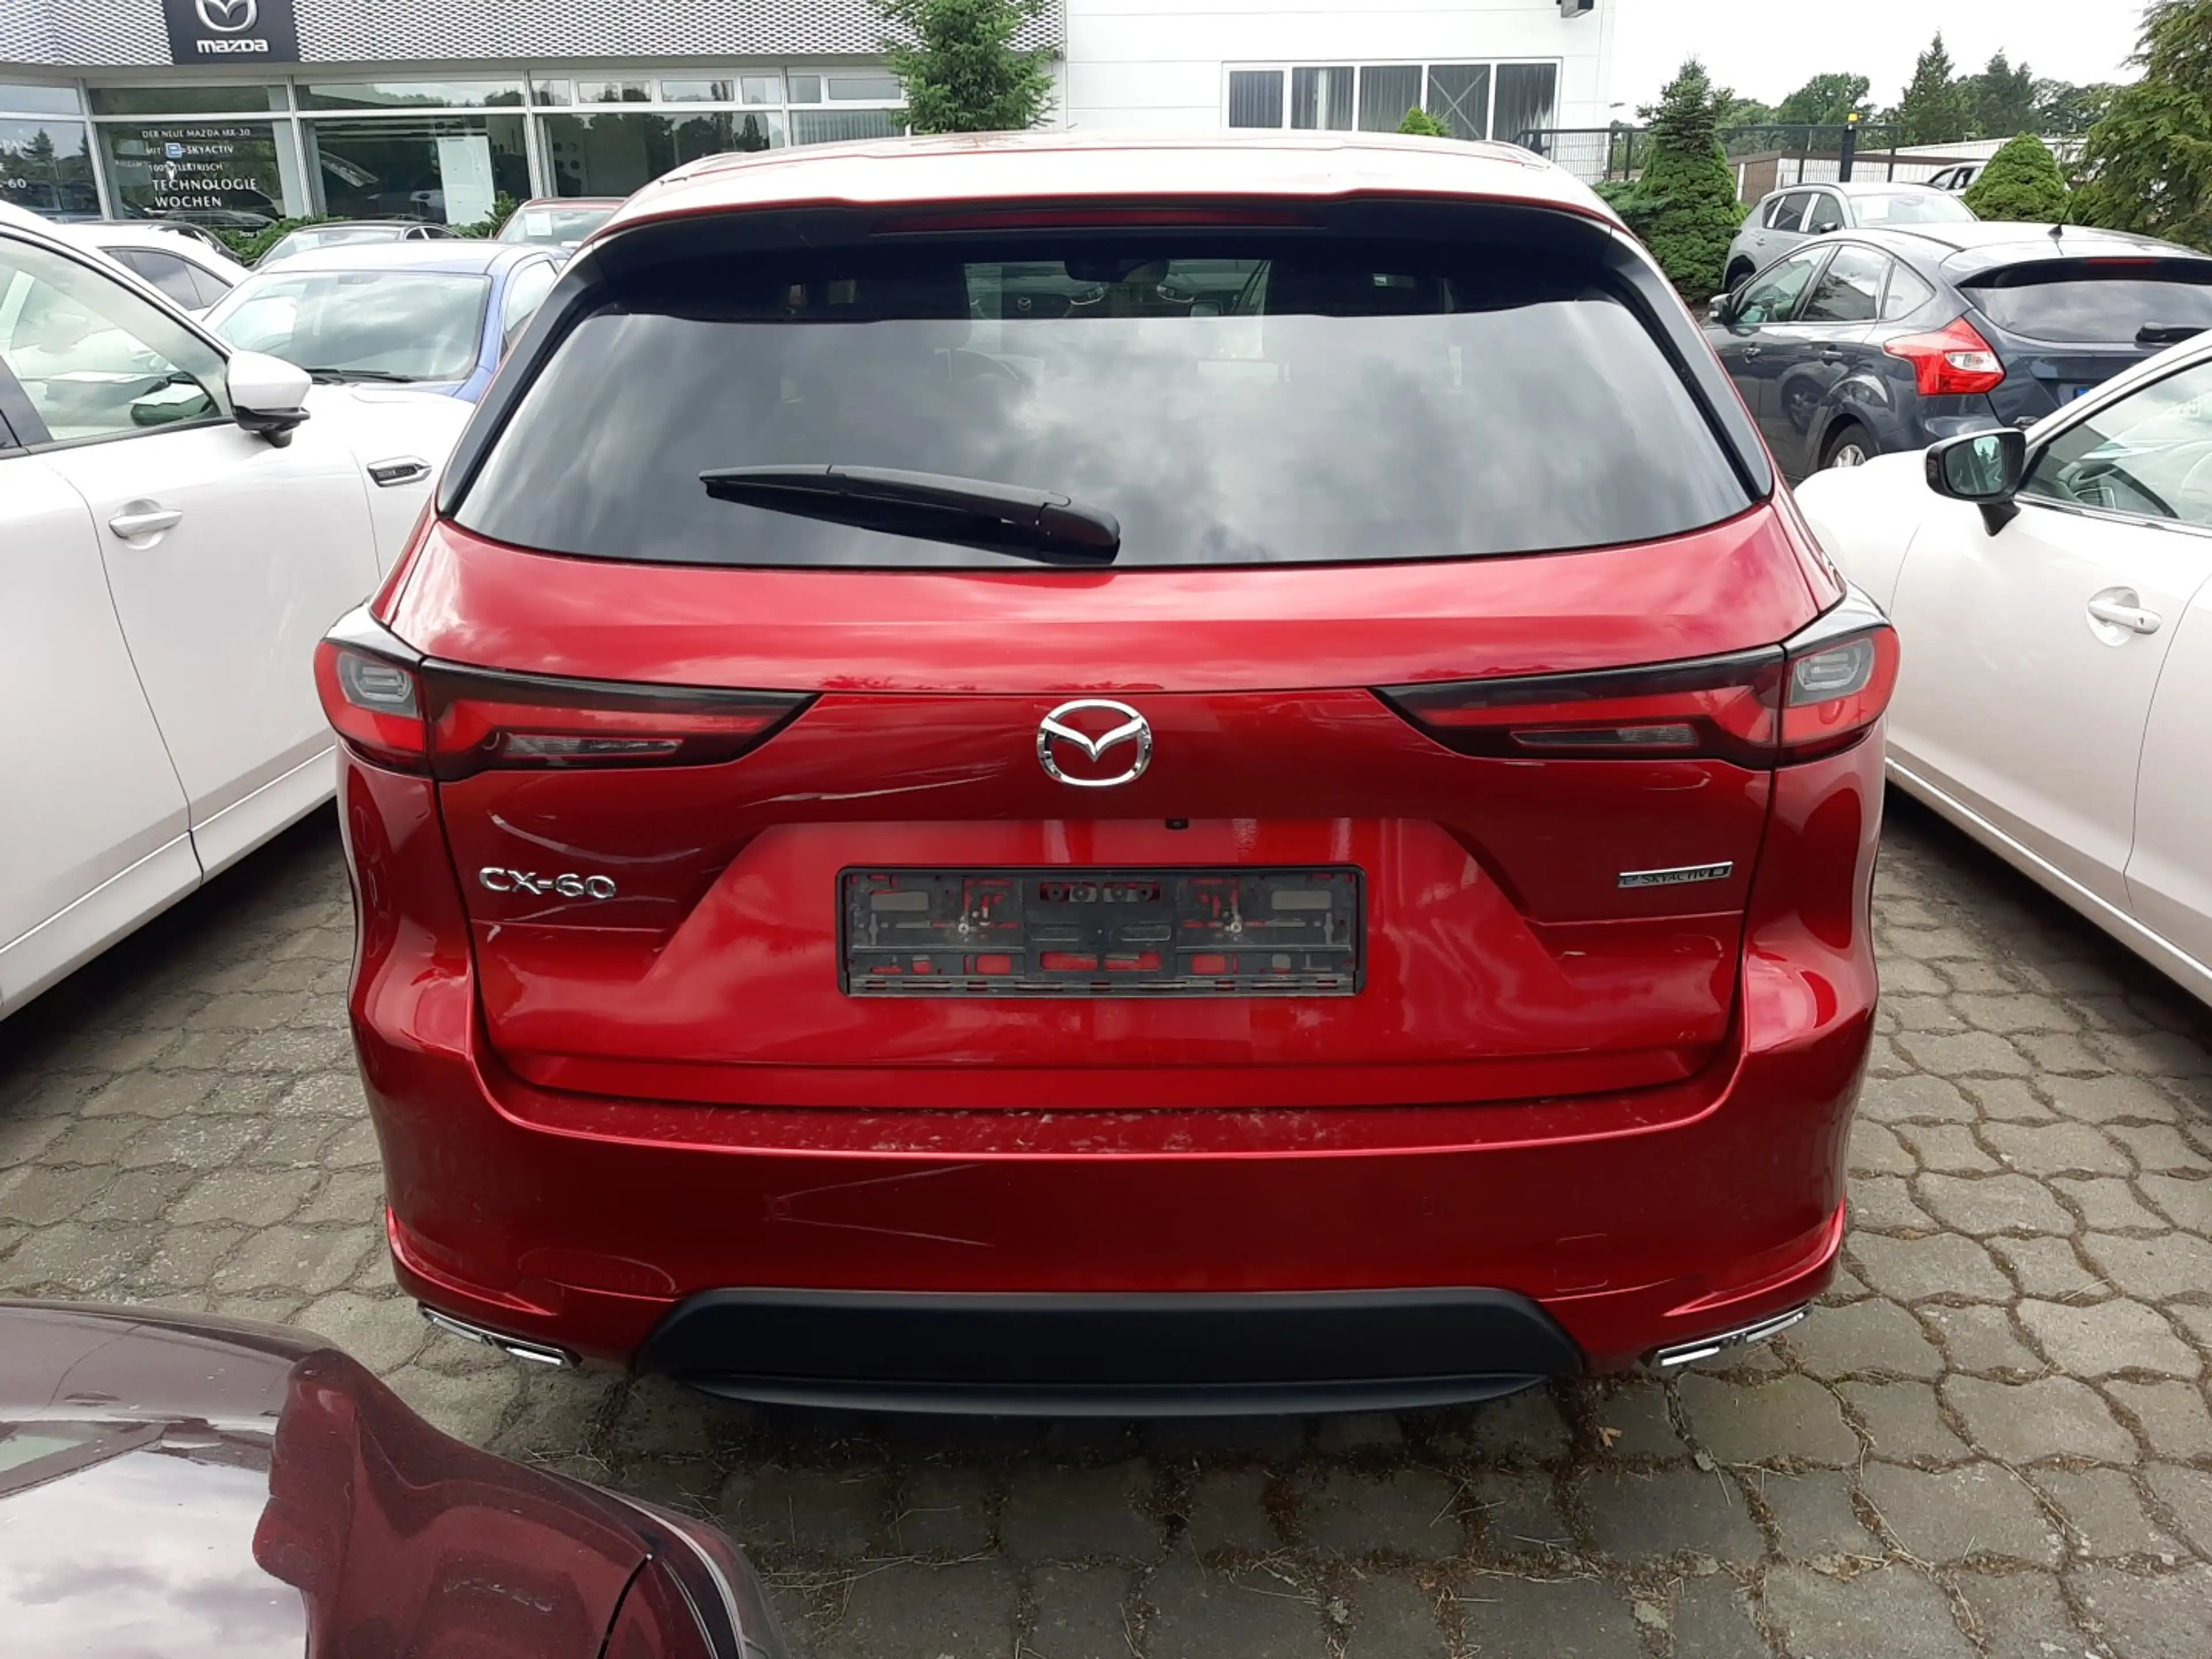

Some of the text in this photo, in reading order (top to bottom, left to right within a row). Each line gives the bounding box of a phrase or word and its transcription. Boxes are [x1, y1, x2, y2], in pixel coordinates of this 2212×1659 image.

[151, 177, 257, 192] TECHNOLOGIE
[154, 195, 222, 208] WOCHEN
[479, 866, 618, 899] CX-60
